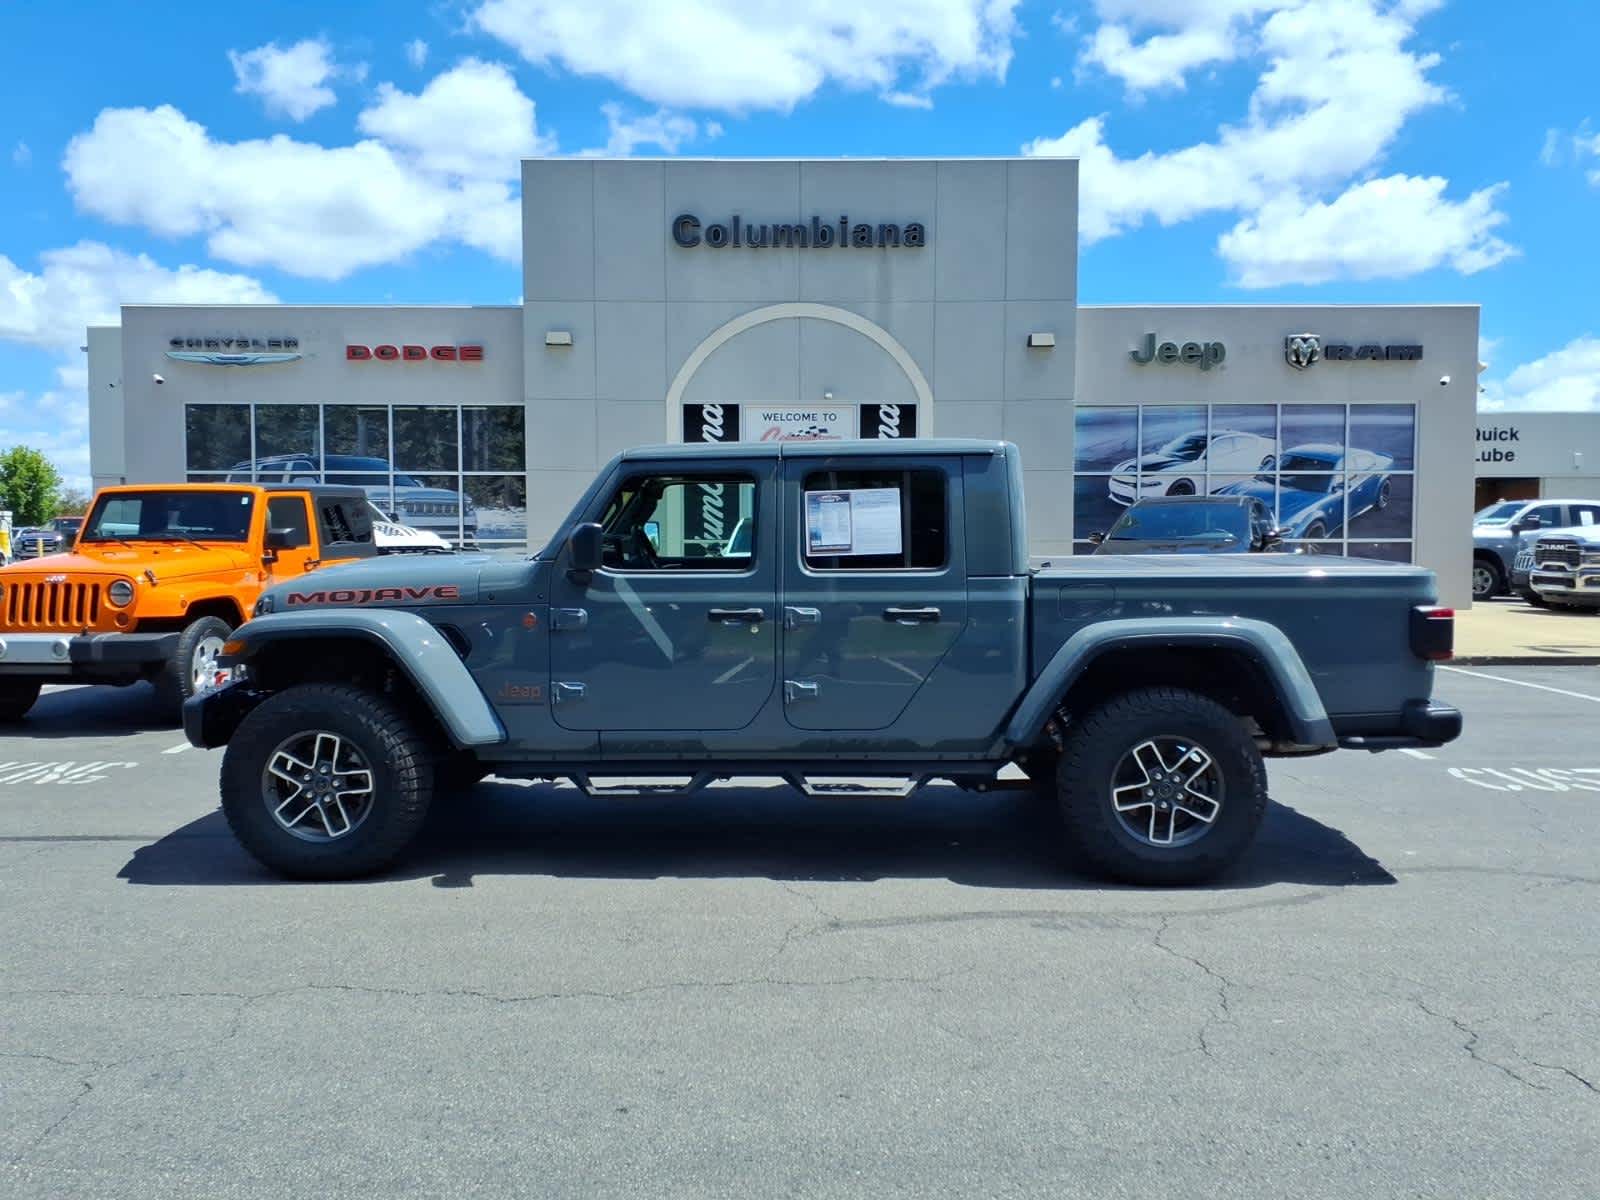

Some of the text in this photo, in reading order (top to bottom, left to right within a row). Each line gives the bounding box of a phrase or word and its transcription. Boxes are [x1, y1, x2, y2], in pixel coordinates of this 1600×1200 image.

[672, 213, 926, 248] Columbiana
[169, 337, 298, 348] CHRYSLER
[346, 345, 482, 361] DODGE
[1128, 332, 1226, 371] Jeep
[1324, 344, 1423, 361] RAM
[762, 413, 837, 421] WELCOME TO
[1476, 427, 1520, 441] uick
[1475, 448, 1515, 462] ube
[288, 586, 460, 605] MOJAVE
